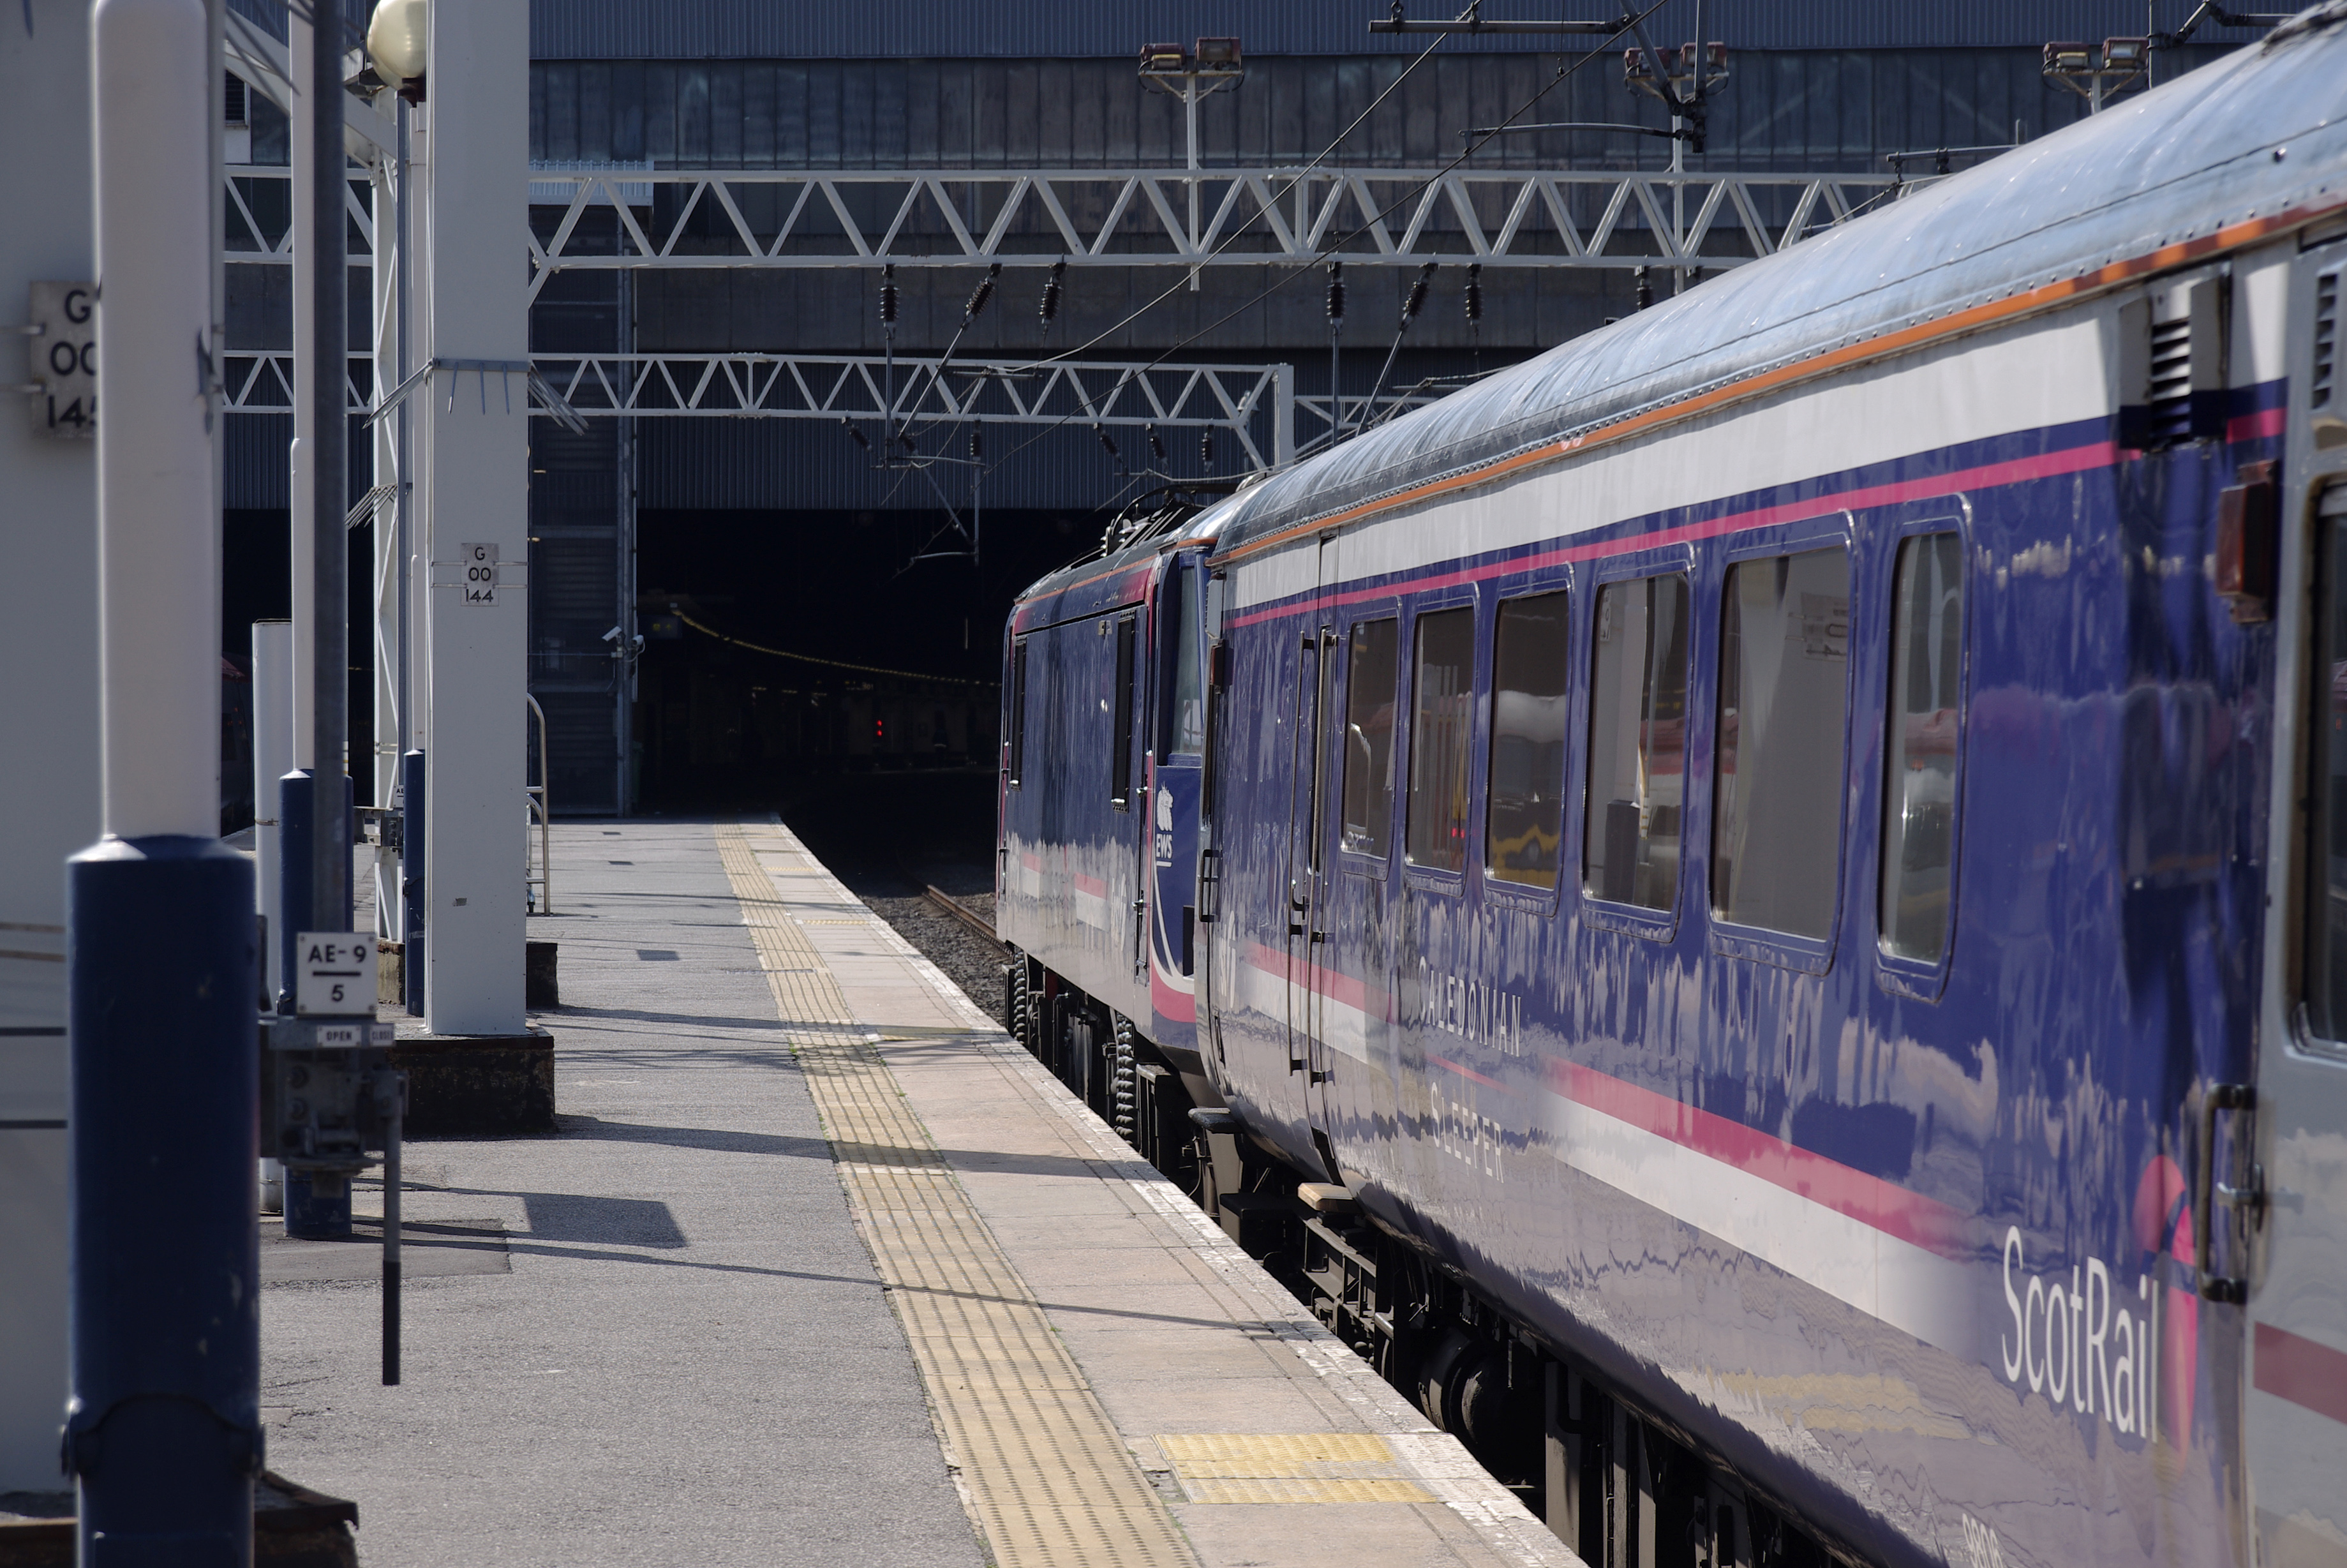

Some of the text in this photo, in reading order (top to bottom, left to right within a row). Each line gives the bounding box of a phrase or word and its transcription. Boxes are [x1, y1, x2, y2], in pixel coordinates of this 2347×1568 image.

[65, 289, 91, 324] G
[48, 394, 96, 428] 14
[475, 547, 485, 560] G
[466, 588, 493, 602] 144
[1156, 833, 1173, 859] EWS
[331, 984, 344, 1002] 5
[1419, 956, 1521, 1057] CALEDONIAN
[326, 1031, 352, 1041] OPEN
[1431, 1082, 1504, 1183] SLEEPER
[2002, 1225, 2159, 1444] ScotRail
